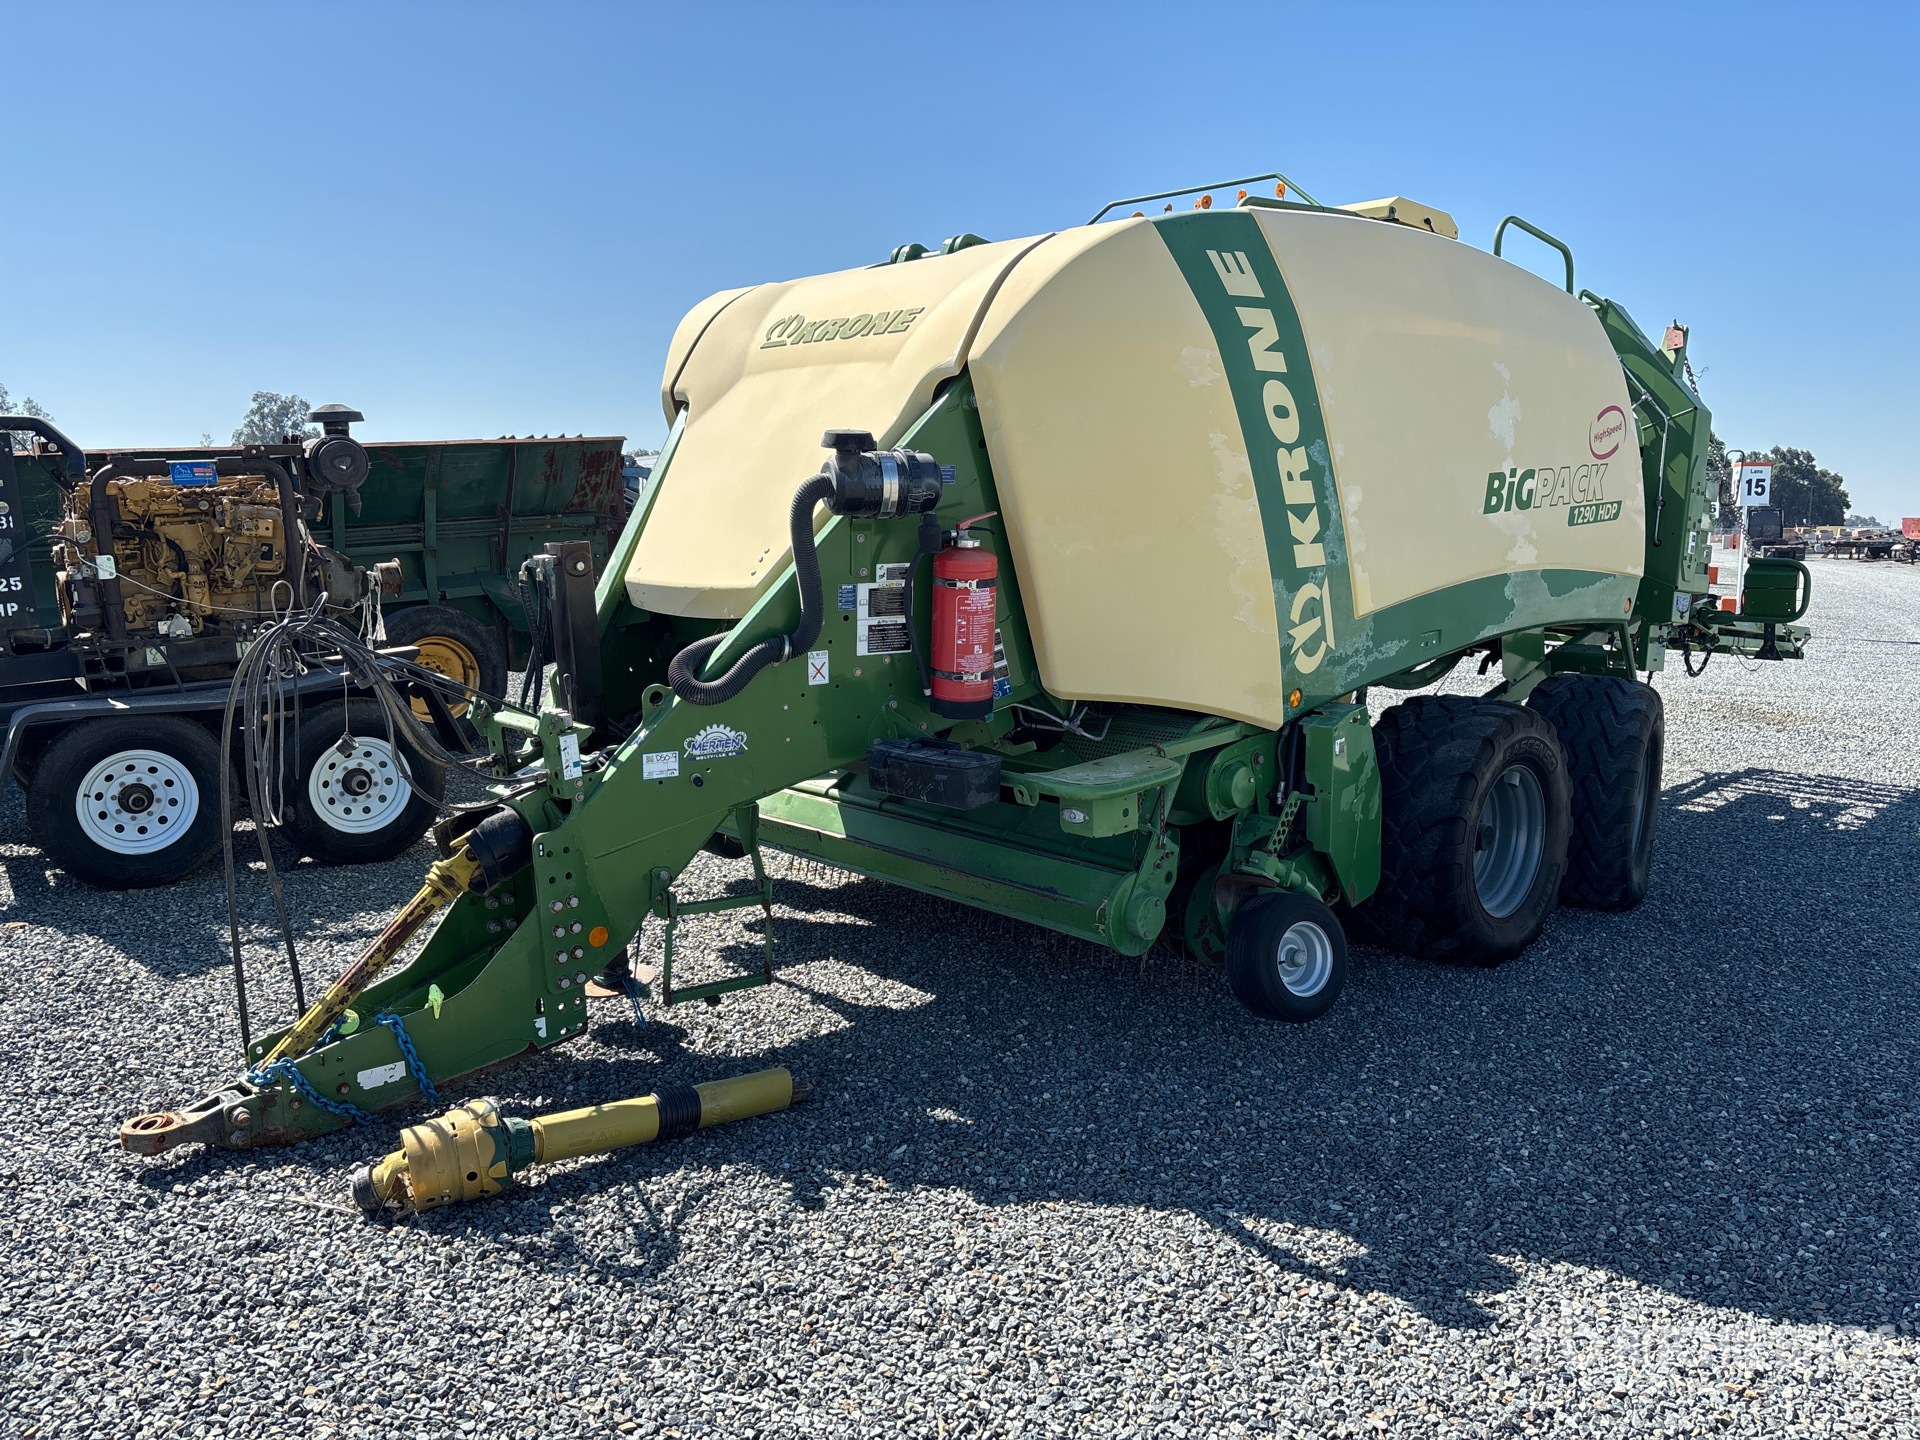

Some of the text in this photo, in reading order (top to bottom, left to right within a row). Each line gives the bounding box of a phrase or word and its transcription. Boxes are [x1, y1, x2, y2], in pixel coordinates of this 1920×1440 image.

[790, 306, 926, 346] KRONE
[1205, 249, 1326, 569] KRONE
[1593, 420, 1623, 443] HighSpeed
[1745, 478, 1766, 496] 15
[1573, 503, 1618, 525] 1290 HDP
[691, 737, 741, 752] MERTEN
